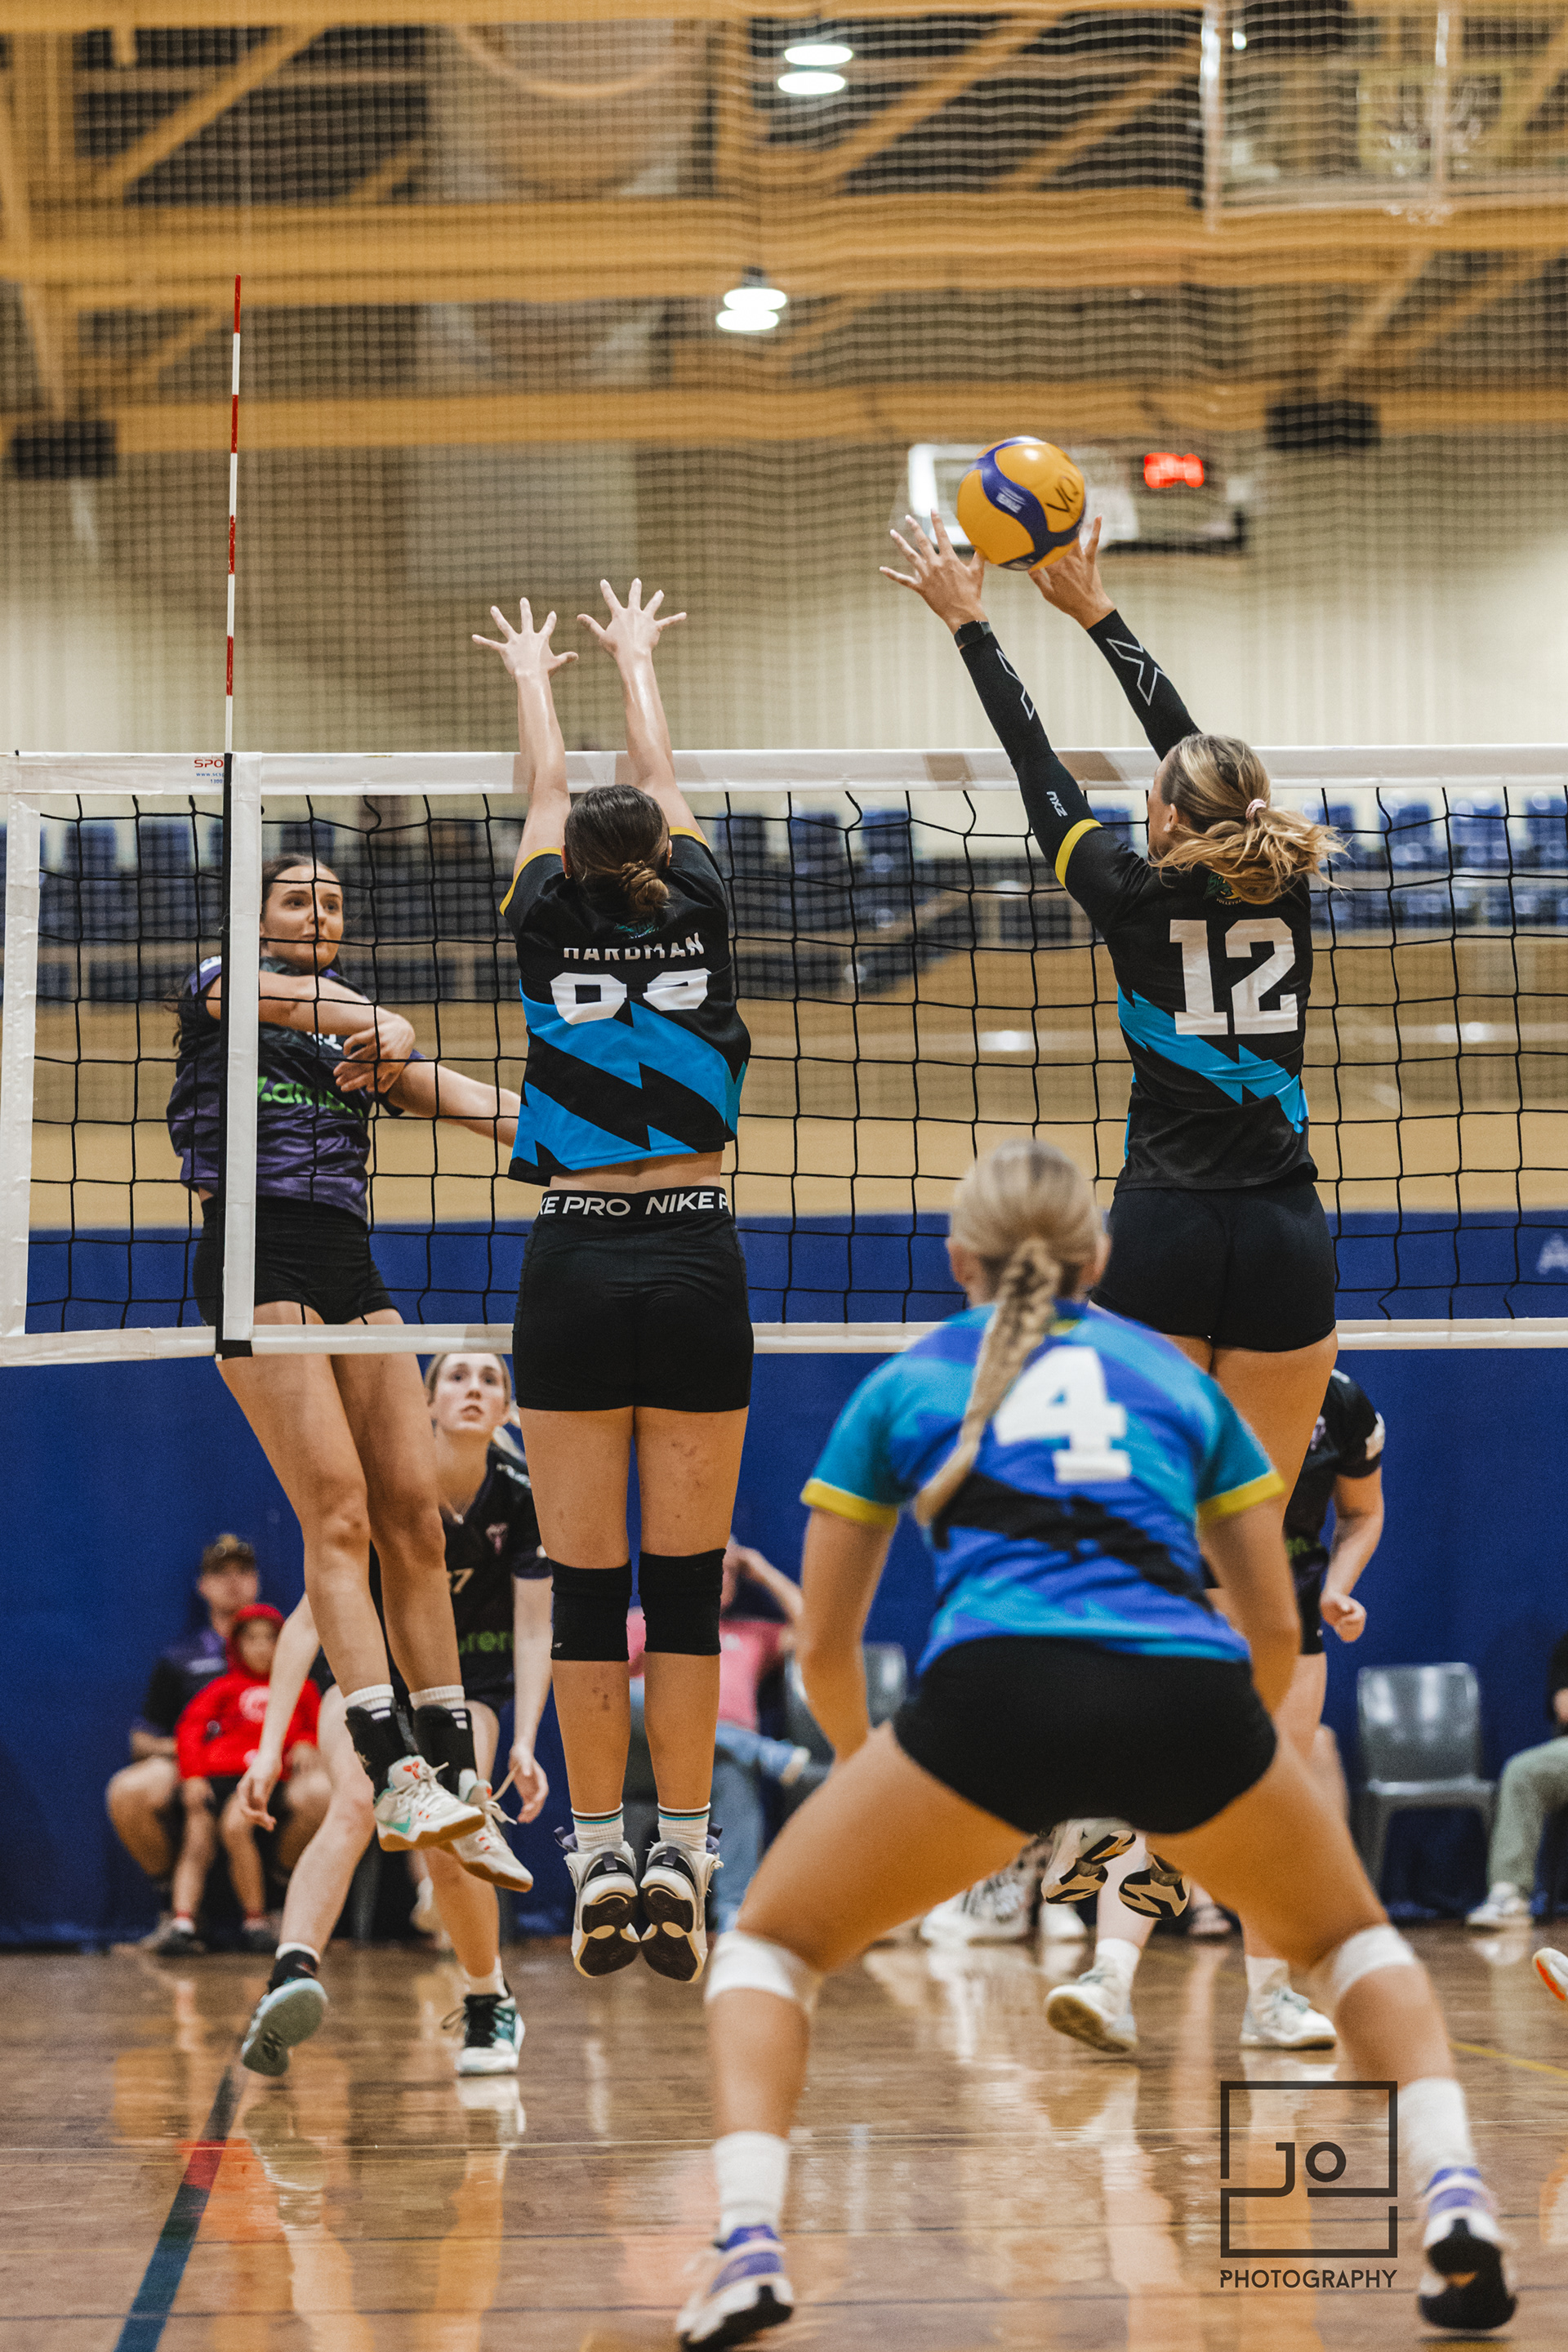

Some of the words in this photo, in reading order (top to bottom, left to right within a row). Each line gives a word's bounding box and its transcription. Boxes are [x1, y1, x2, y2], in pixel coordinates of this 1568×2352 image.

[194, 759, 224, 768] SPO
[564, 932, 705, 961] HARDMAN
[1169, 917, 1298, 1036] 12
[562, 1196, 631, 1217] PRO
[645, 1192, 715, 1216] NIKE
[993, 1346, 1133, 1485] 4
